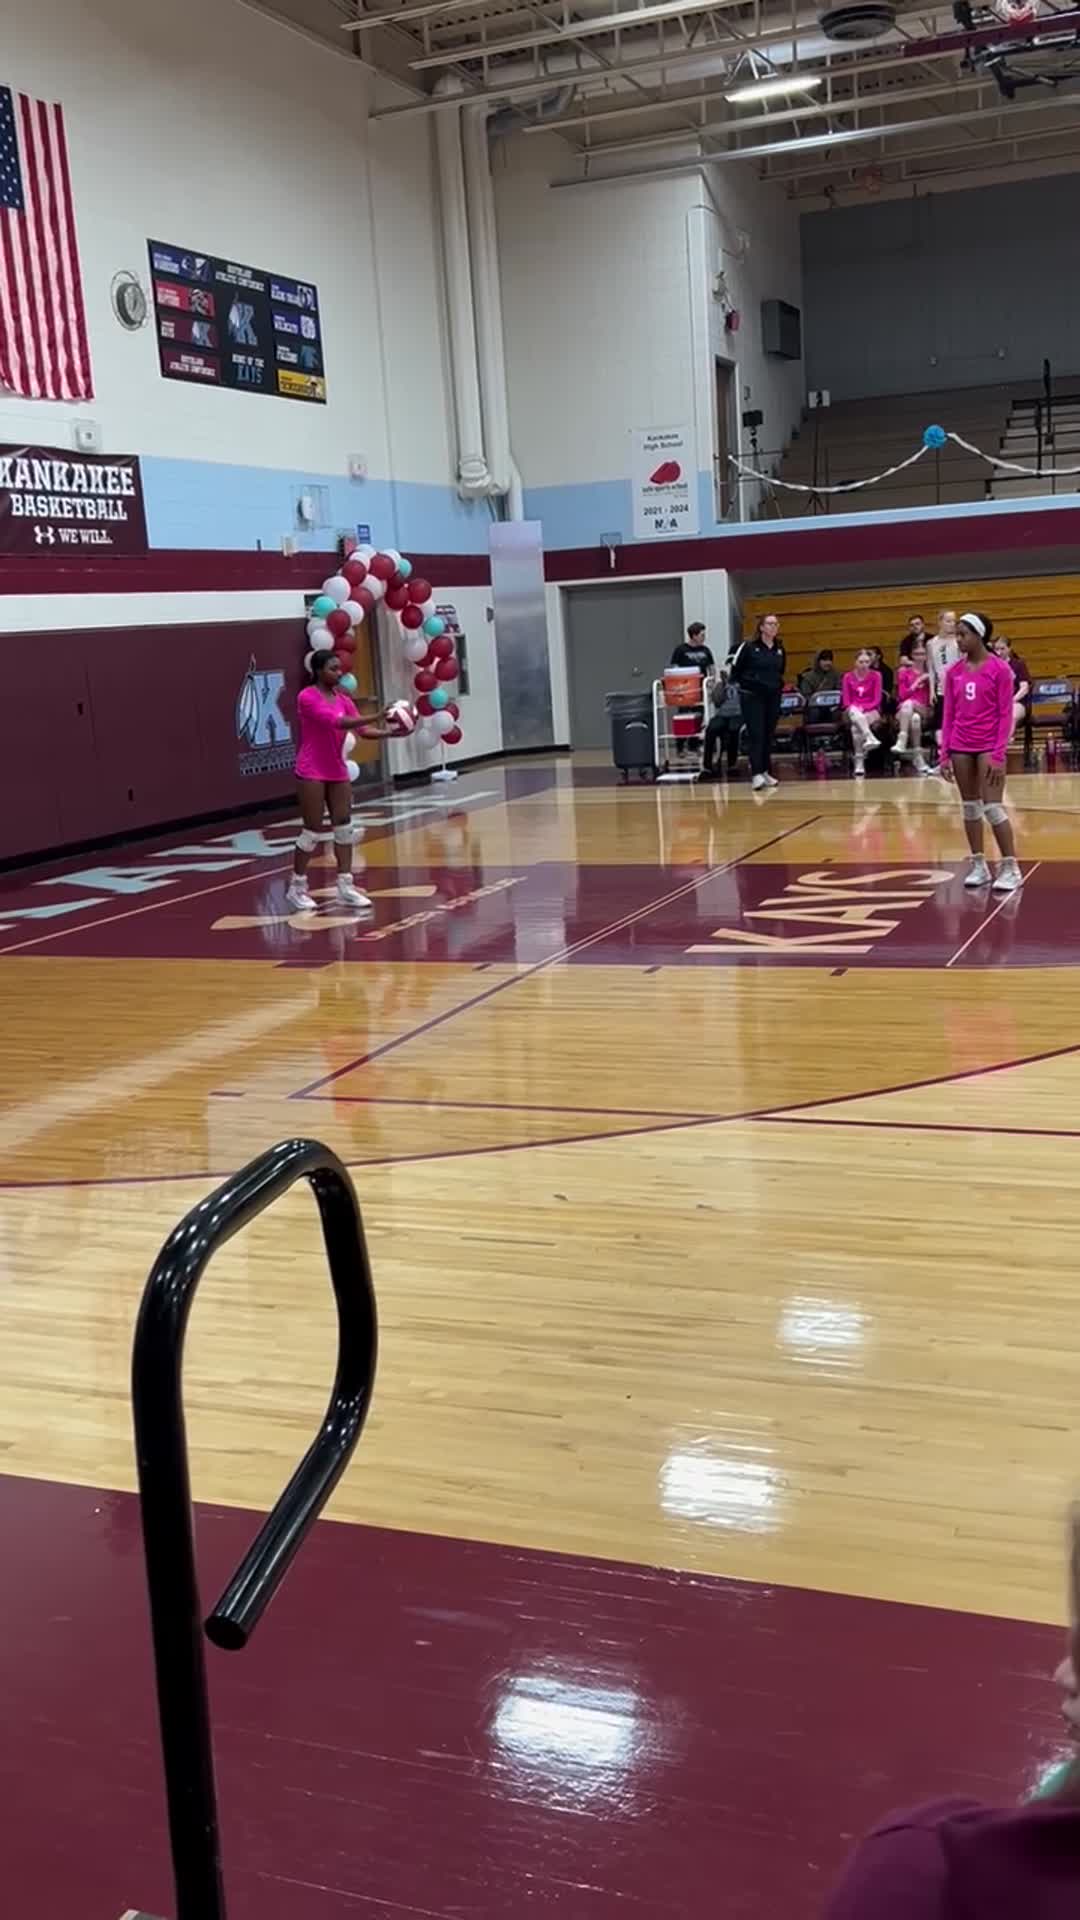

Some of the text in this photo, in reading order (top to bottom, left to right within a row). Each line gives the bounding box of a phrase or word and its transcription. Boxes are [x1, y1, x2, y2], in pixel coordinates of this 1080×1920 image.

[0, 457, 136, 496] KANKAKEE
[10, 493, 128, 521] BASKETBALL
[643, 505, 662, 516] 2021
[669, 503, 689, 514] 2024
[58, 528, 79, 543] WE
[965, 681, 976, 700] 9
[684, 868, 955, 954] KAYS
